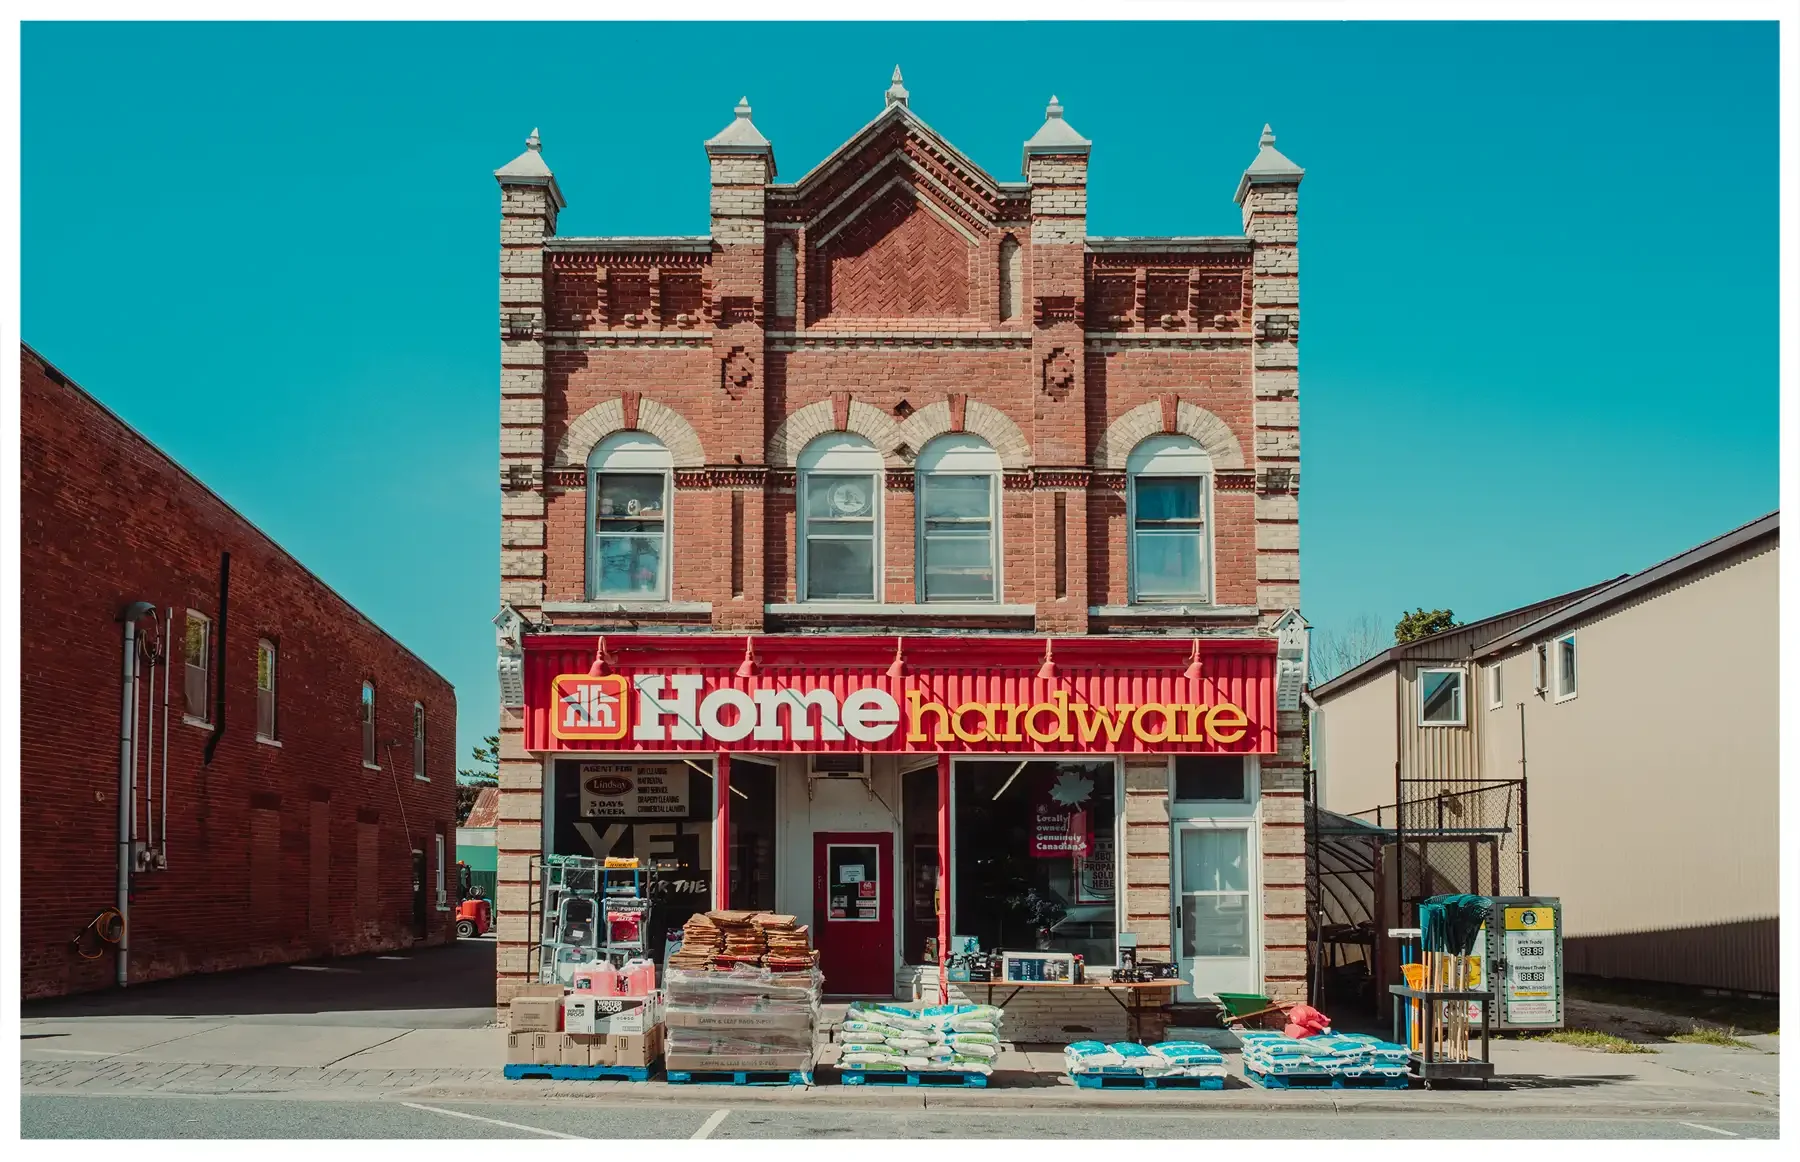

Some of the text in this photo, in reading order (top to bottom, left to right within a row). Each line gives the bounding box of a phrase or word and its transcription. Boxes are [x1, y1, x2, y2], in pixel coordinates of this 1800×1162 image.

[633, 674, 1248, 743] Home hardware
[593, 780, 627, 790] Lindsay
[1036, 814, 1068, 823] Locally
[1036, 833, 1082, 843] Genuinely
[572, 822, 714, 871] YET
[1092, 872, 1114, 880] SOLD
[672, 880, 707, 893] THE
[1092, 880, 1115, 888] HERE
